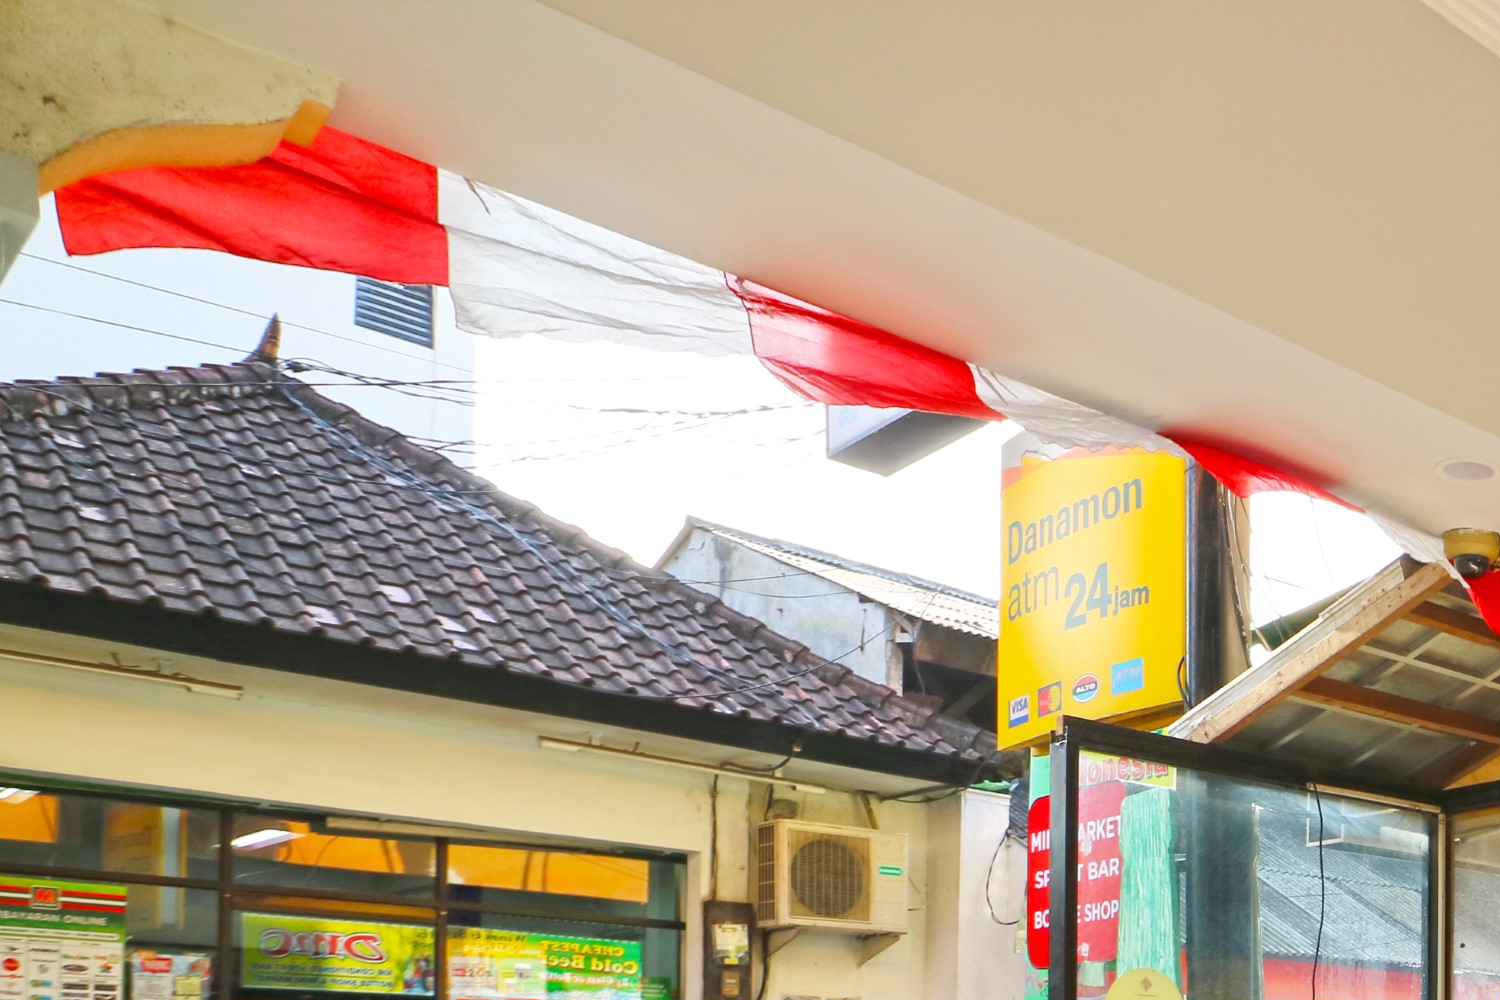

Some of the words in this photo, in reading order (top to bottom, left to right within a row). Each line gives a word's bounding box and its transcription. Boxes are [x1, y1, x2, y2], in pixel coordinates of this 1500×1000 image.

[1008, 478, 1143, 565] Danamon
[1008, 566, 1060, 622] atm
[1064, 562, 1112, 632] 24
[1112, 584, 1150, 616] jam
[1076, 682, 1096, 694] ALTO
[1012, 700, 1028, 714] VISA
[1077, 814, 1122, 842] ARKET
[1088, 857, 1119, 881] BAR
[1085, 900, 1119, 920] SHOP
